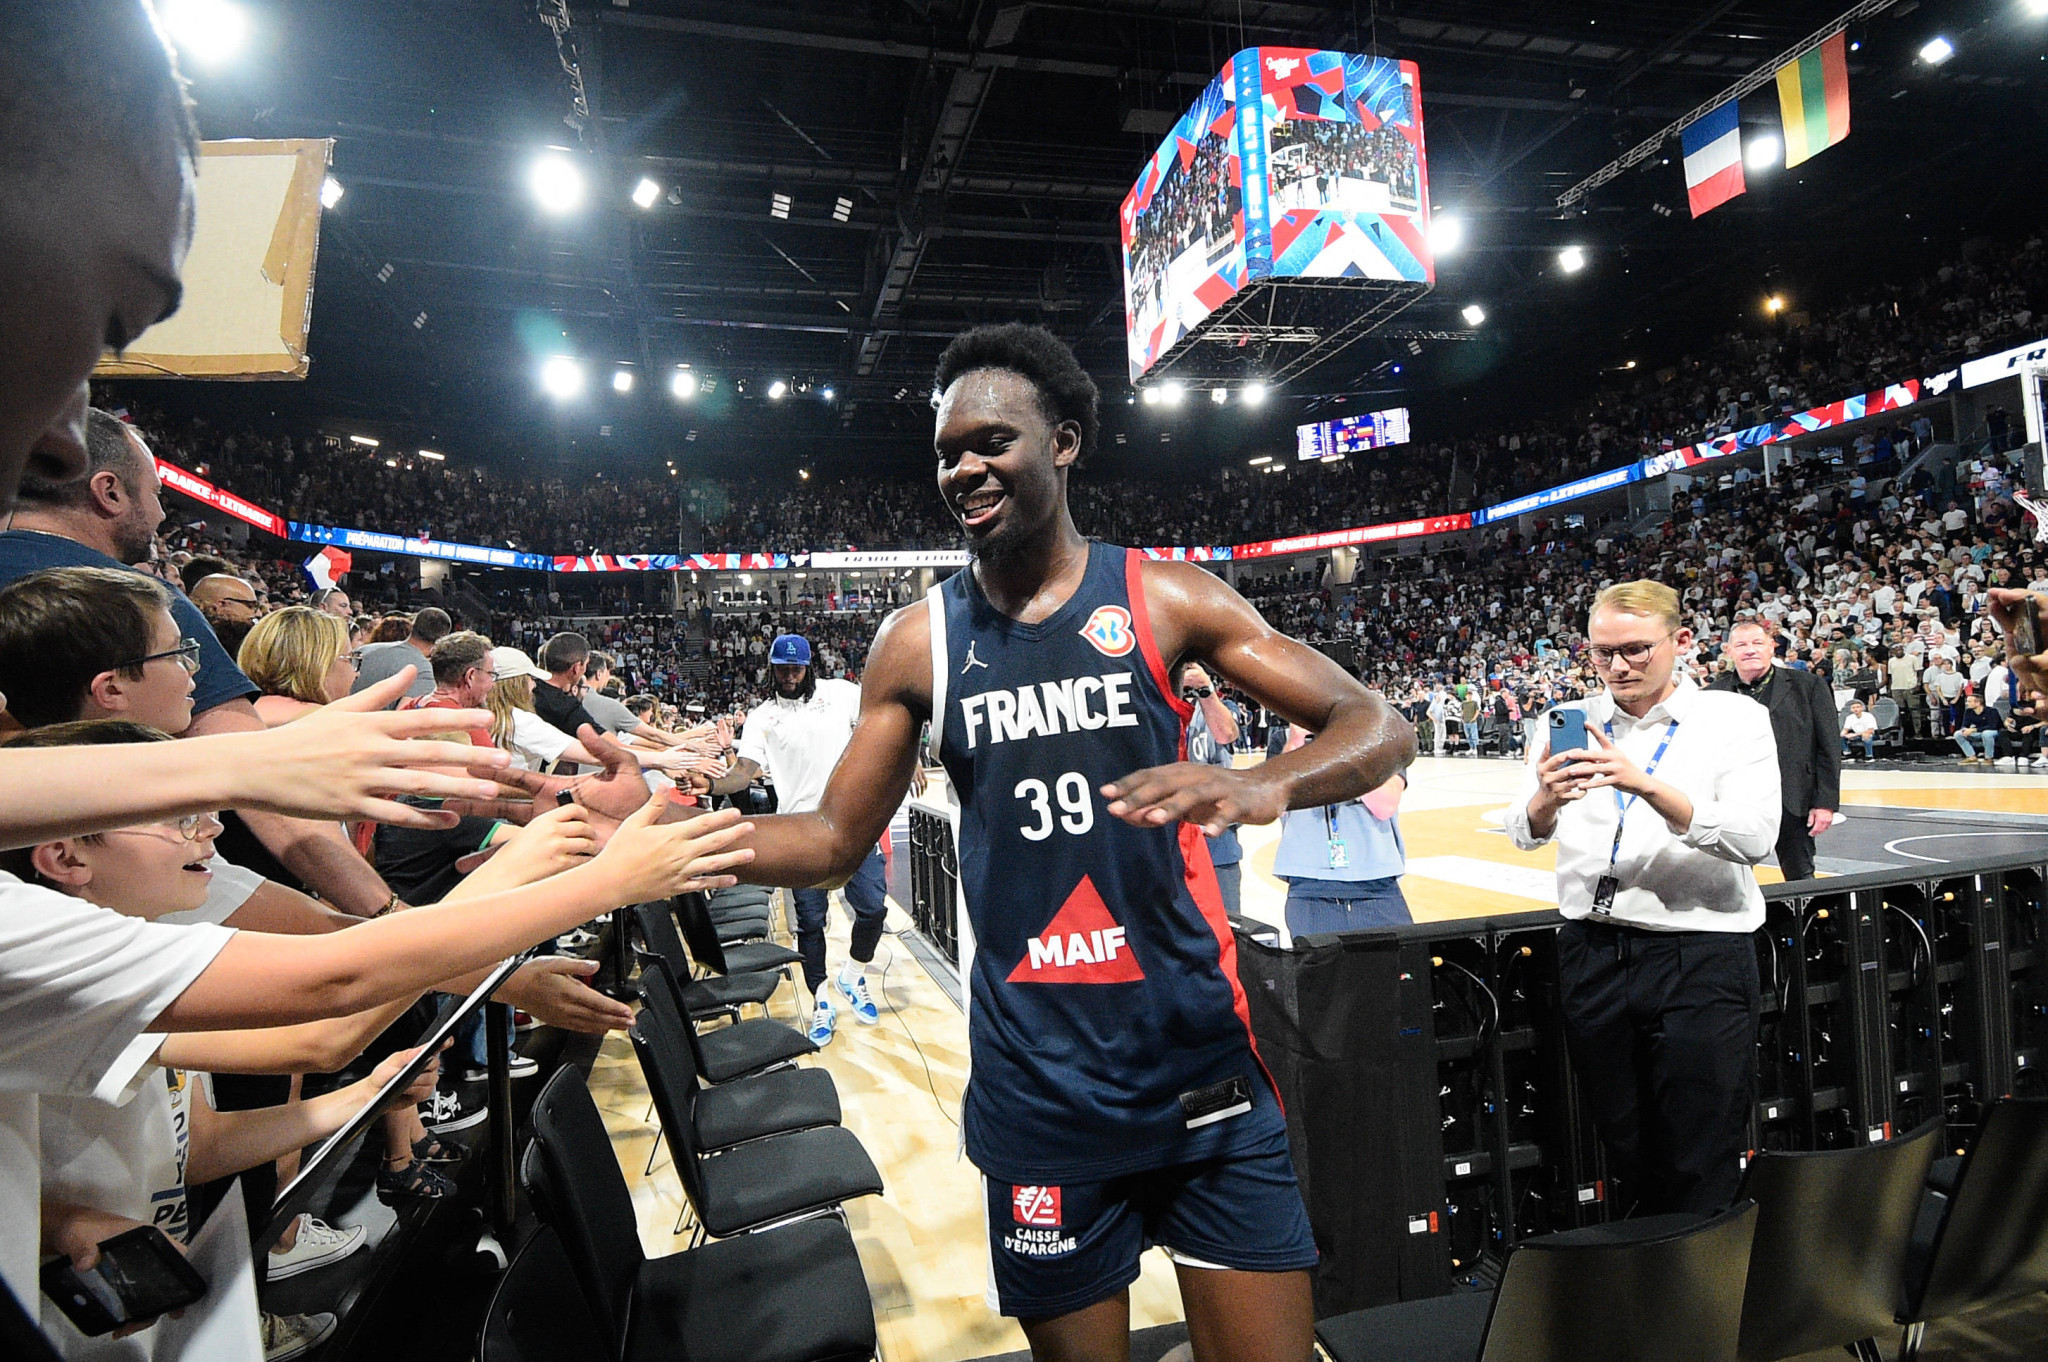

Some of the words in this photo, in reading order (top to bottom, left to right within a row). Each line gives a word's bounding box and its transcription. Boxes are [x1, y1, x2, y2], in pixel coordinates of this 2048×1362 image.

[159, 465, 211, 499] FRANCE
[346, 531, 405, 551] PRÉPARATION
[959, 671, 1139, 750] FRANCE
[1013, 771, 1094, 842] 39
[1027, 925, 1126, 970] MAIF
[1004, 1235, 1077, 1255] D'EPARGNE
[1015, 1227, 1060, 1242] CAISSE
